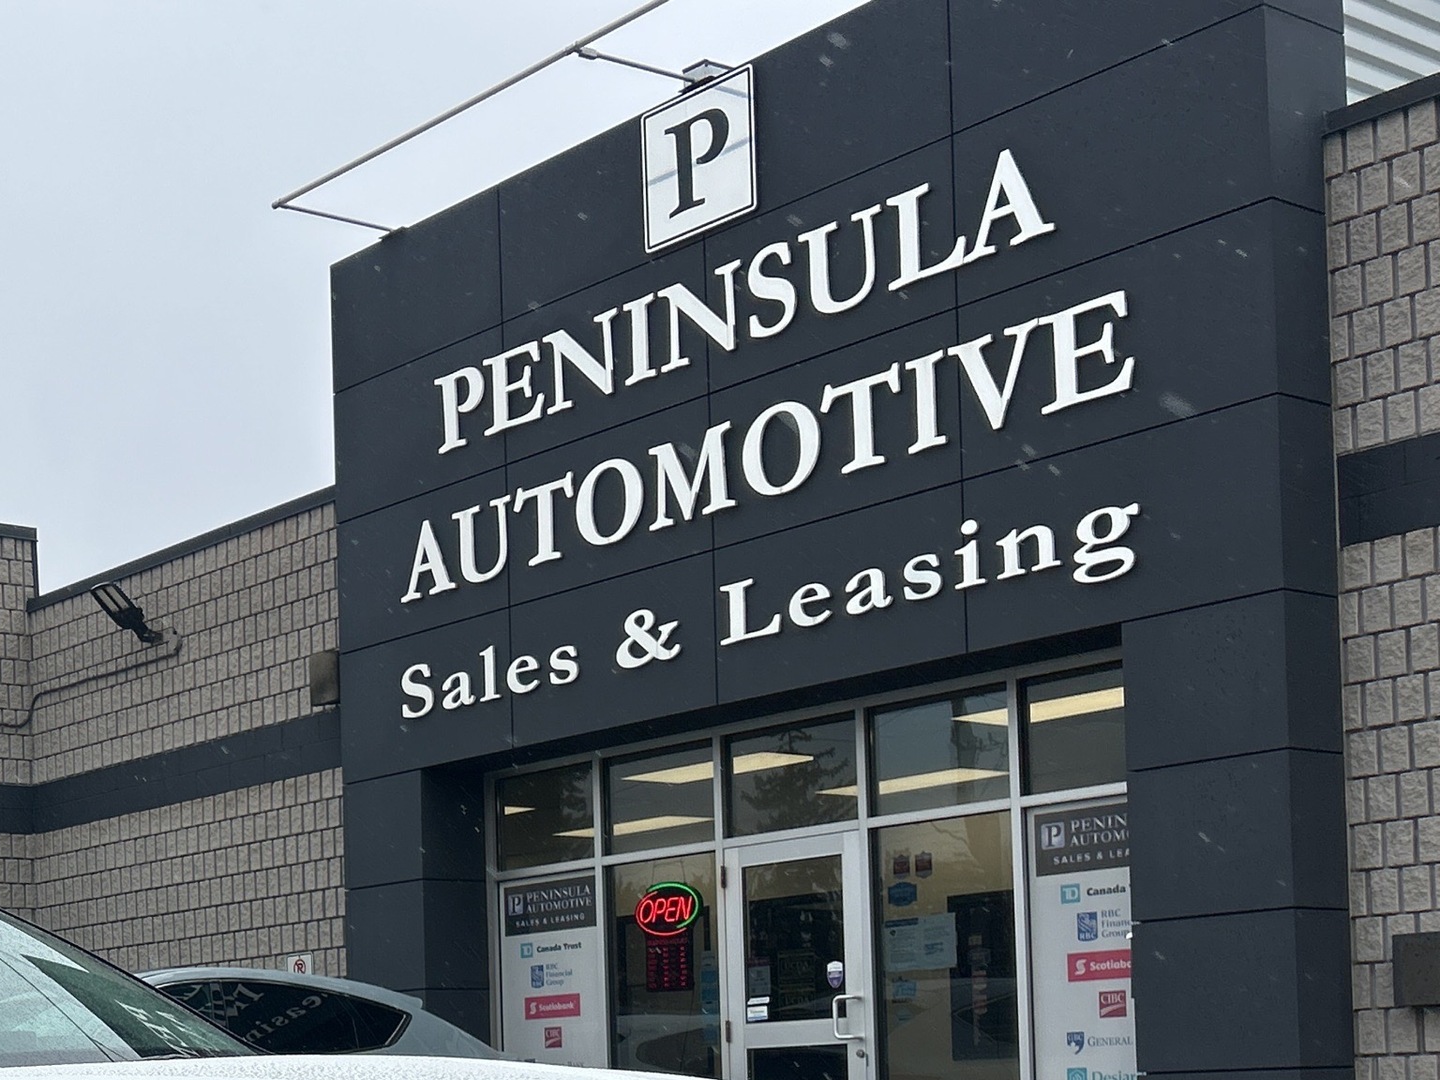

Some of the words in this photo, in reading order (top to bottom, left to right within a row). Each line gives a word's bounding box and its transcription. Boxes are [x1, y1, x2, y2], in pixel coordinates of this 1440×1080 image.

[664, 107, 730, 217] P
[435, 149, 1056, 455] PENINSULA
[400, 290, 1137, 605] AUTOMOTIVE
[400, 643, 580, 720] Sales
[615, 607, 682, 670] &
[719, 502, 1142, 647] Leasing
[1071, 813, 1128, 833] PENIN
[1053, 853, 1091, 865] SALES
[1097, 850, 1103, 860] &
[526, 884, 592, 903] PENINSULA
[1086, 884, 1127, 897] Canada
[526, 896, 593, 914] AUTOMOTIVE
[640, 895, 693, 924] OPEN
[1101, 909, 1121, 918] RBC
[515, 918, 540, 929] SALES
[550, 913, 586, 924] LEASING
[536, 943, 562, 953] Canada
[563, 941, 582, 951] Trust
[1100, 992, 1125, 1005] CIBC
[1087, 1036, 1133, 1047] GENERAL
